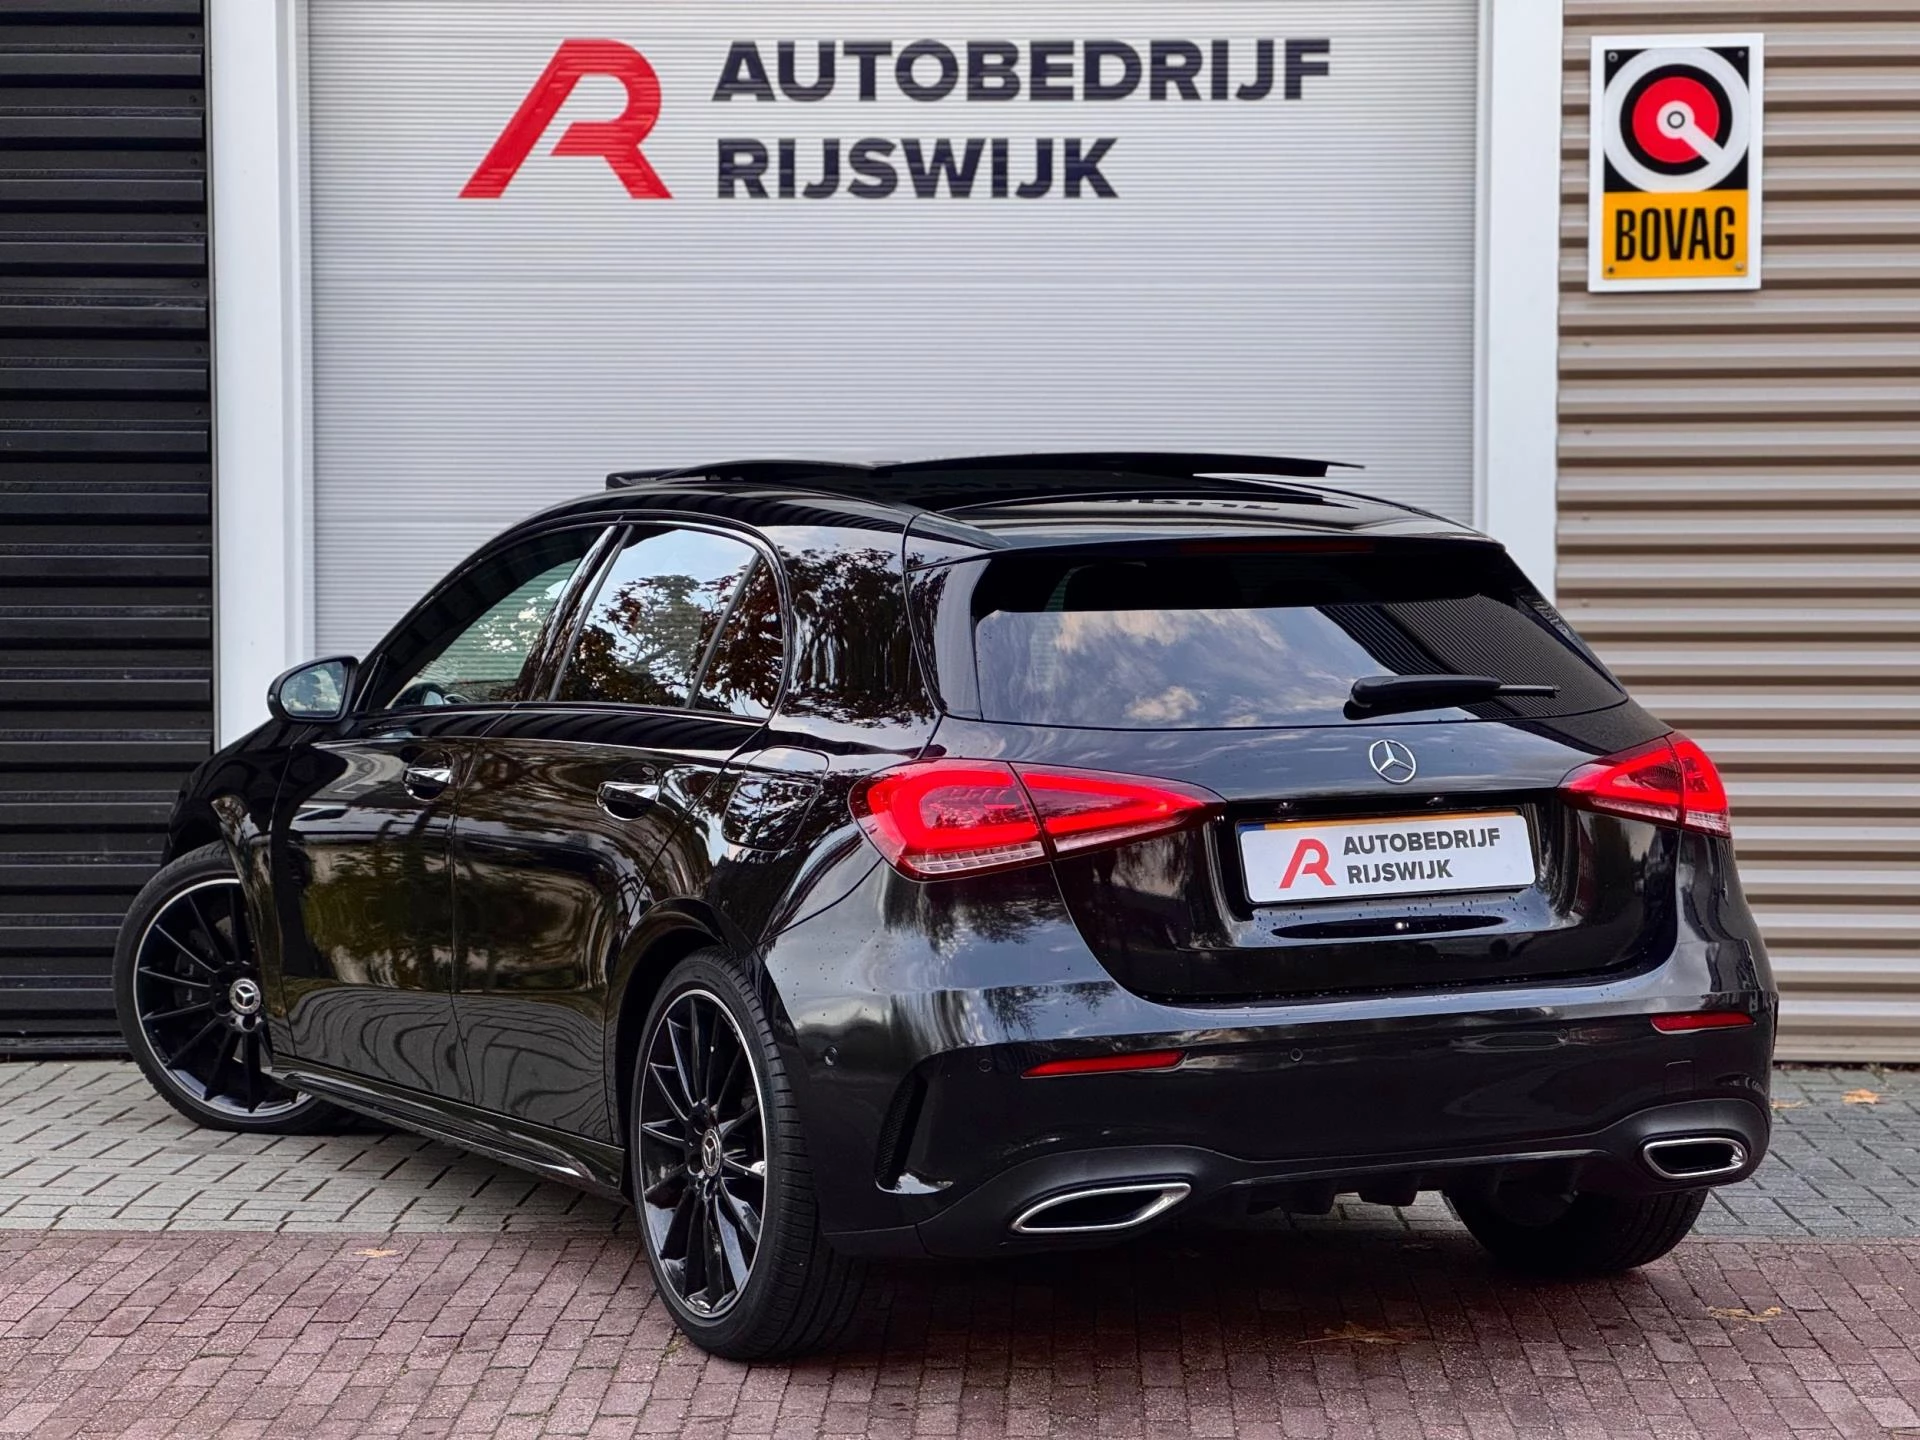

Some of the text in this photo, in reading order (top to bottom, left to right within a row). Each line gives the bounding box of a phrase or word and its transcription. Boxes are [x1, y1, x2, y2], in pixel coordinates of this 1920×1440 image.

[713, 39, 1330, 102] AUTOBEDRIJF
[718, 138, 1118, 199] RIJSWIJK
[1615, 206, 1735, 262] BOVAG
[1344, 828, 1500, 855] AUTOBEDRIJF
[1347, 859, 1453, 884] RIJSWIJK
